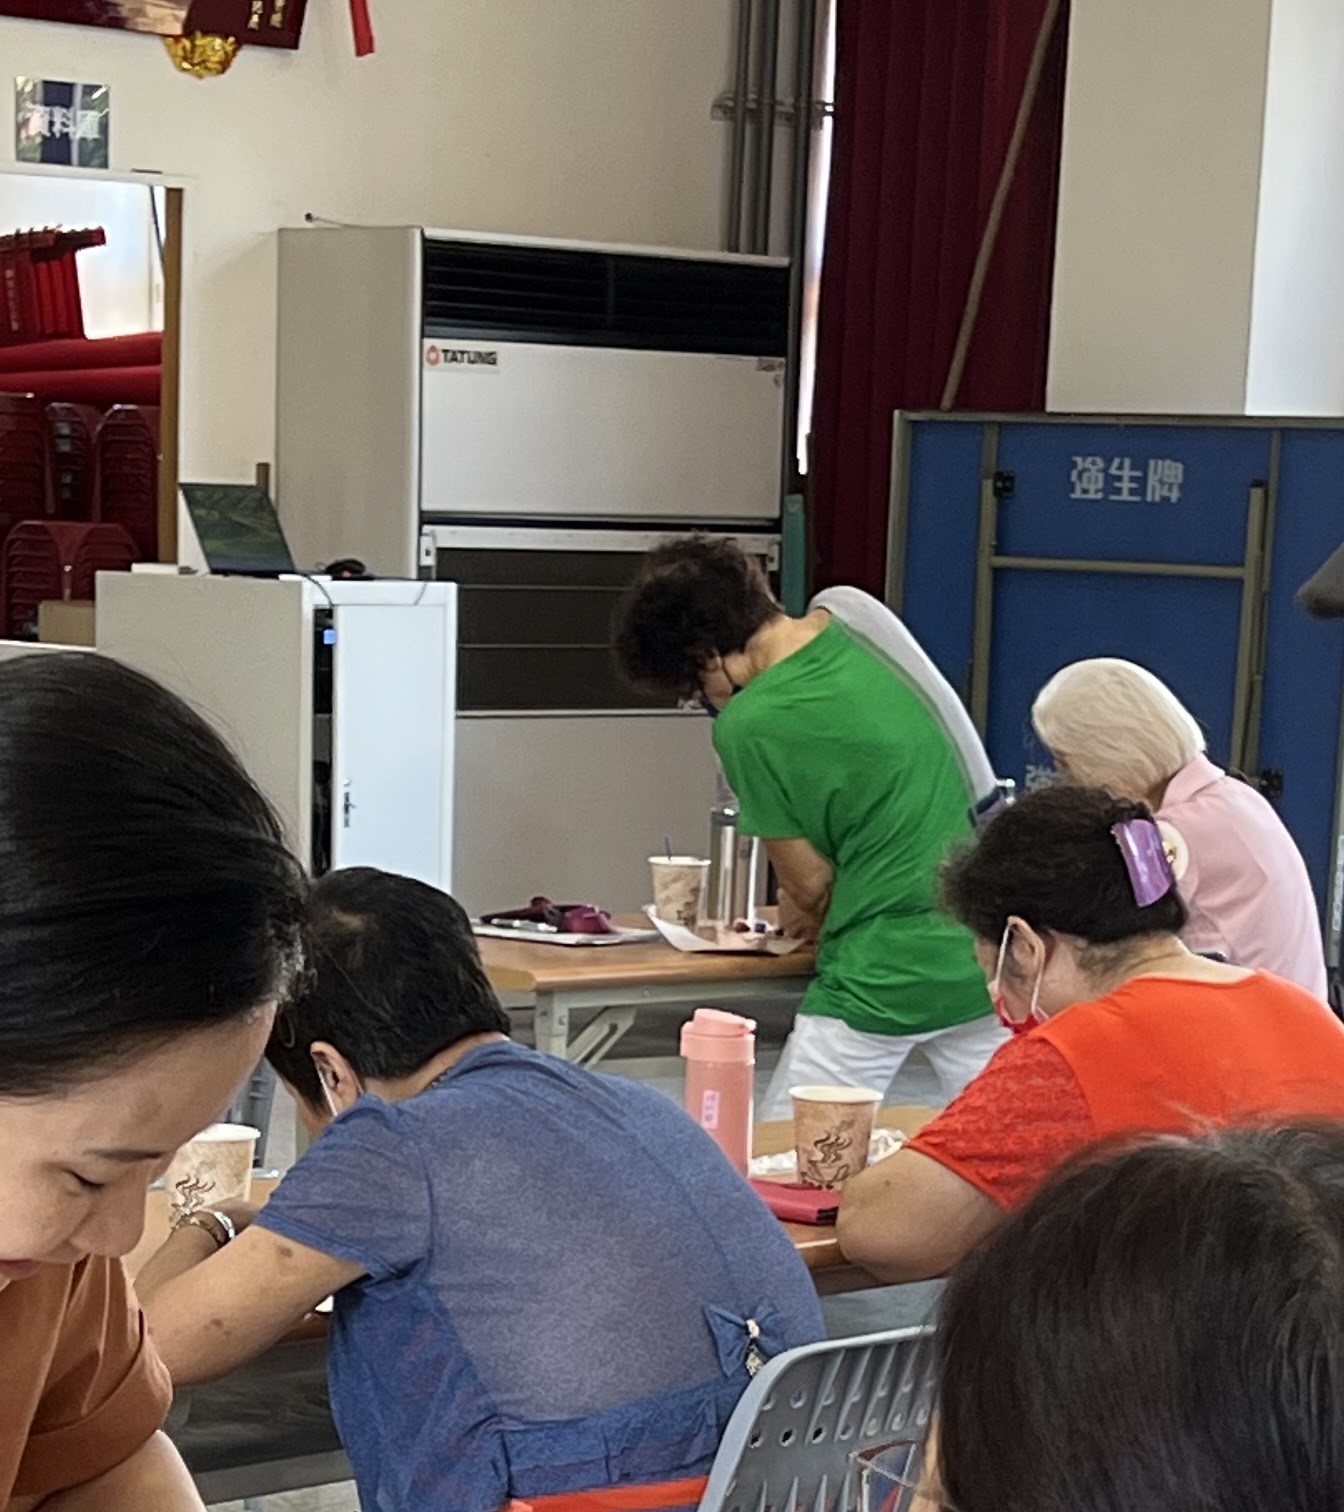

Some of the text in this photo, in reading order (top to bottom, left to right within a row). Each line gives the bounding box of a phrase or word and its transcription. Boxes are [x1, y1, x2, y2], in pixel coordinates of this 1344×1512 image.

[442, 349, 497, 365] TATUNG
[1070, 456, 1184, 503] 強生牌
